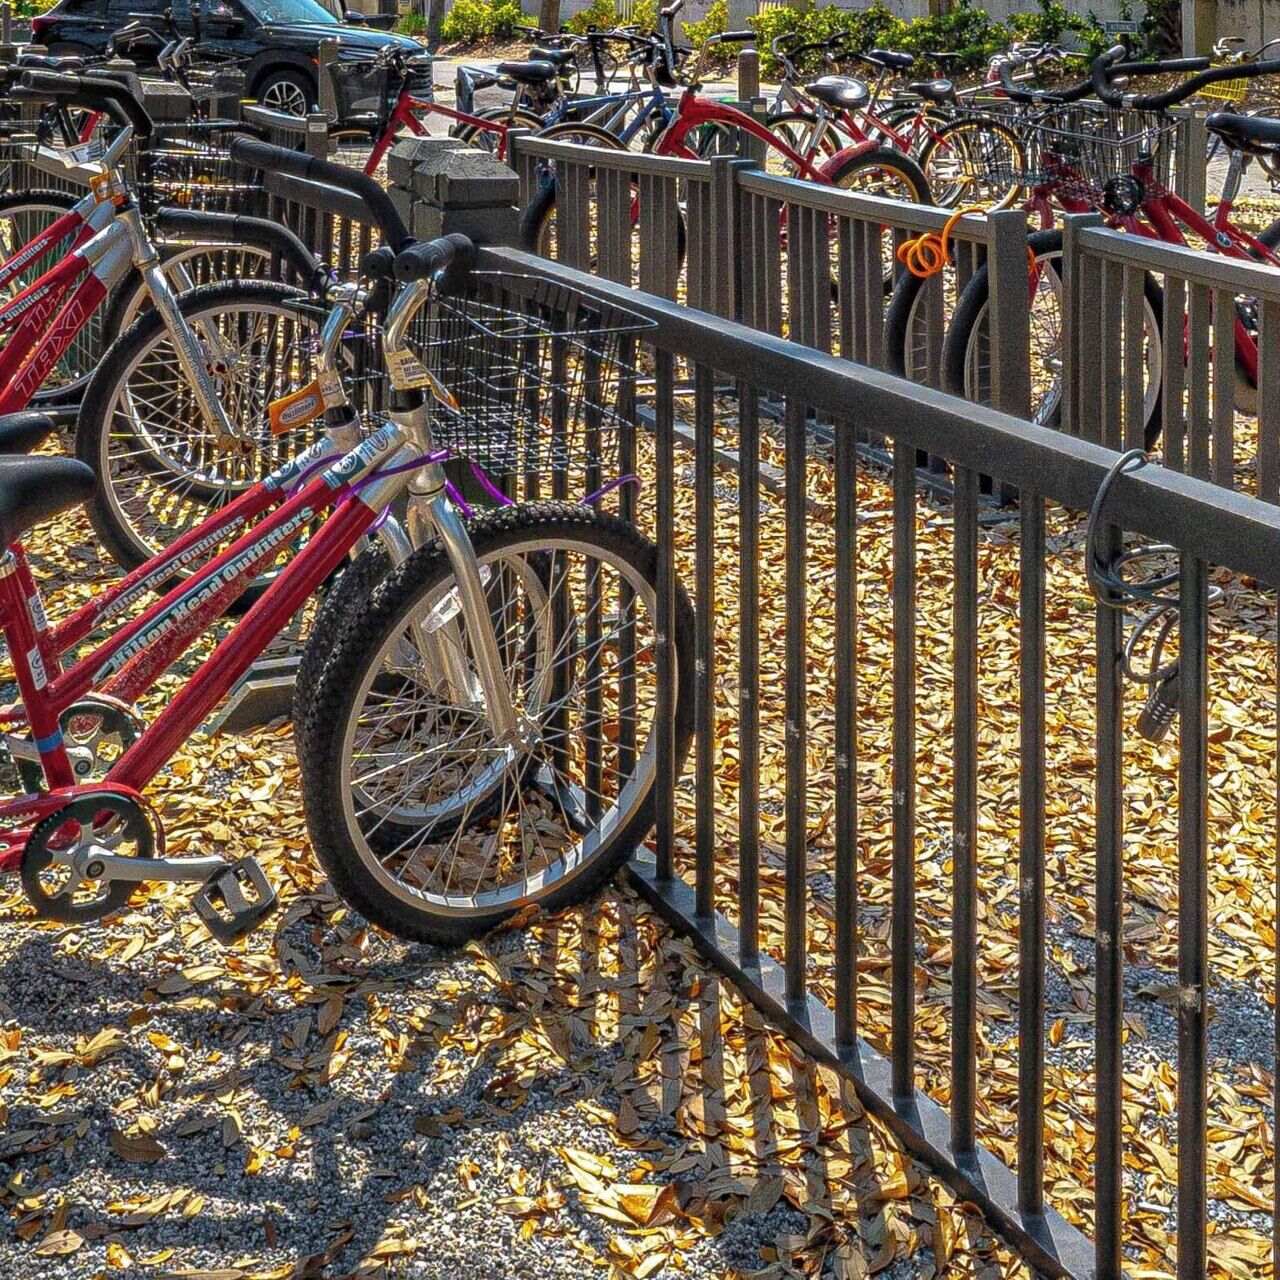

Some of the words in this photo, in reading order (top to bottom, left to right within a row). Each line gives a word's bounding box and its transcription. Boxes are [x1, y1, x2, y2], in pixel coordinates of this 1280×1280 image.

[10, 237, 49, 271] Outfitters
[3, 285, 50, 322] Outfitters
[104, 587, 150, 619] Hilton
[146, 560, 182, 592] Head
[181, 514, 247, 565] Outfitters
[111, 616, 173, 671] Hilton
[170, 576, 225, 623] Head
[223, 504, 316, 582] Outfitters
